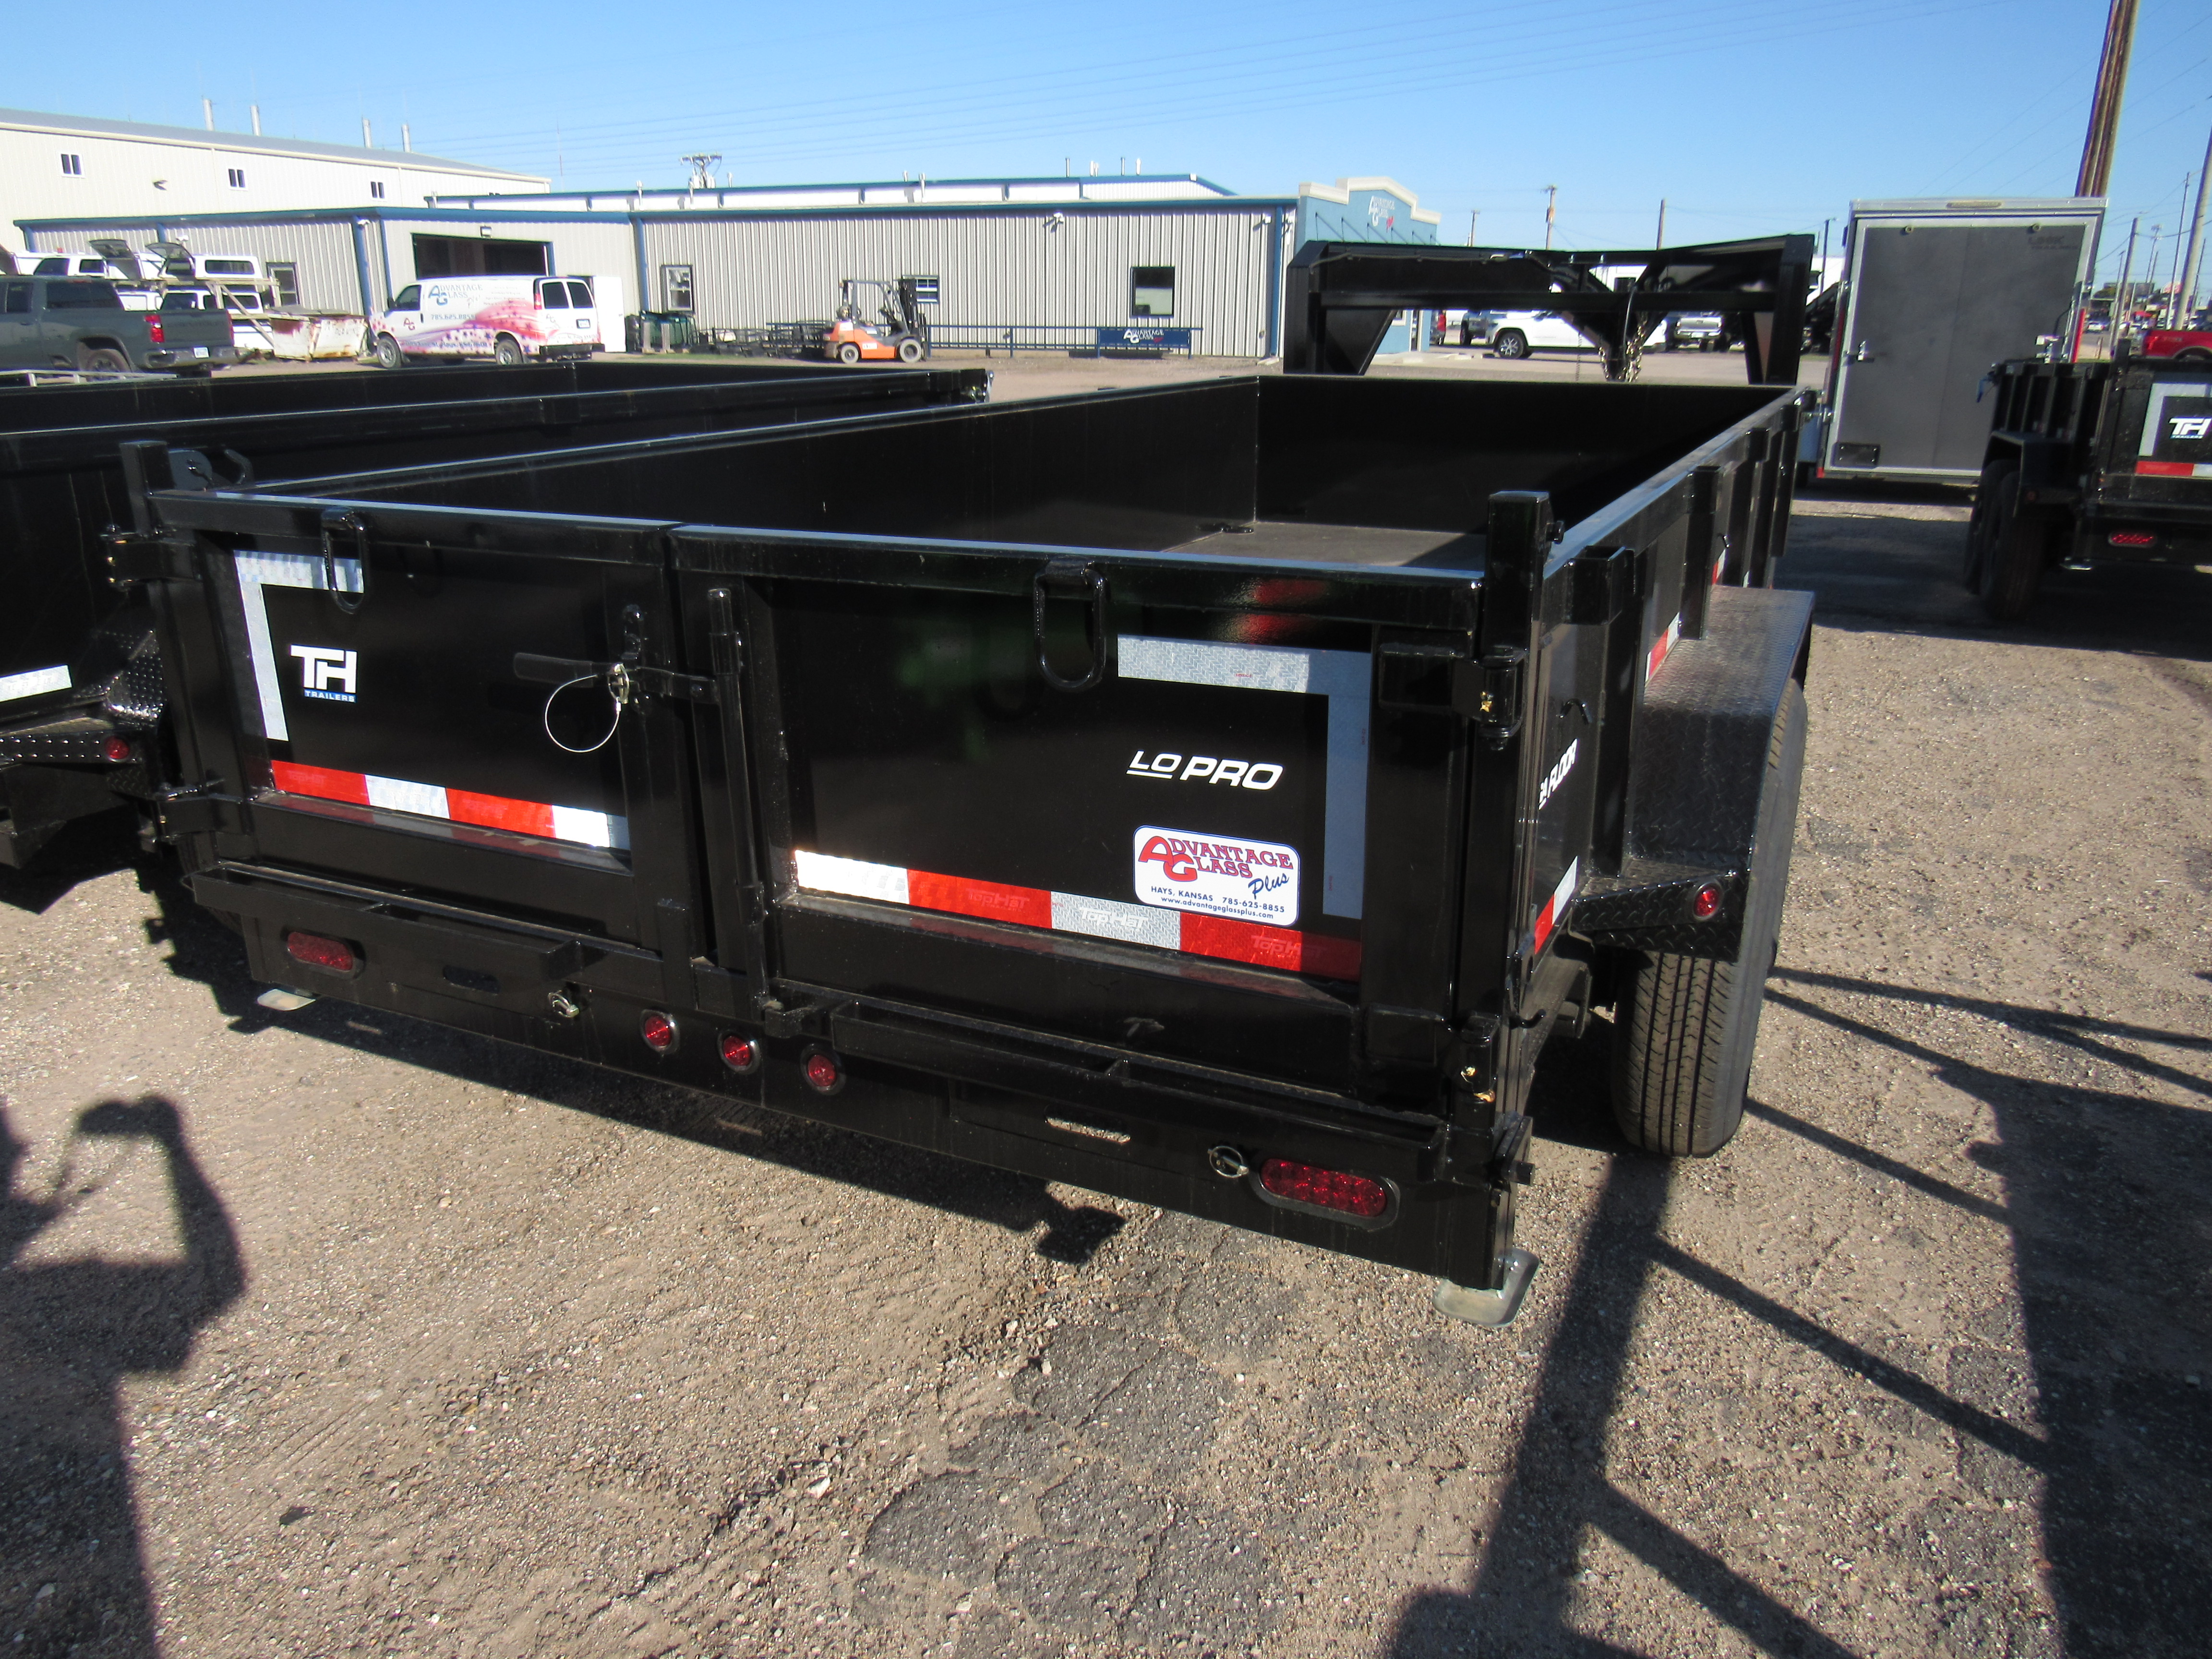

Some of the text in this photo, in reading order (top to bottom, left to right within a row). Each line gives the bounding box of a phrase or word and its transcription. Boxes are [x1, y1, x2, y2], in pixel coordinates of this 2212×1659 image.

[290, 644, 358, 694] TH
[304, 689, 355, 703] TRAILERS
[1179, 755, 1284, 791] PRO
[1138, 836, 1294, 870] ADVANTAGE
[1163, 854, 1253, 882] GLASS
[1151, 886, 1285, 913] HAYS, KANSAS 785-625-8855
[1248, 873, 1290, 900] Plus
[1161, 896, 1274, 919] www.advantageglassplus.com
